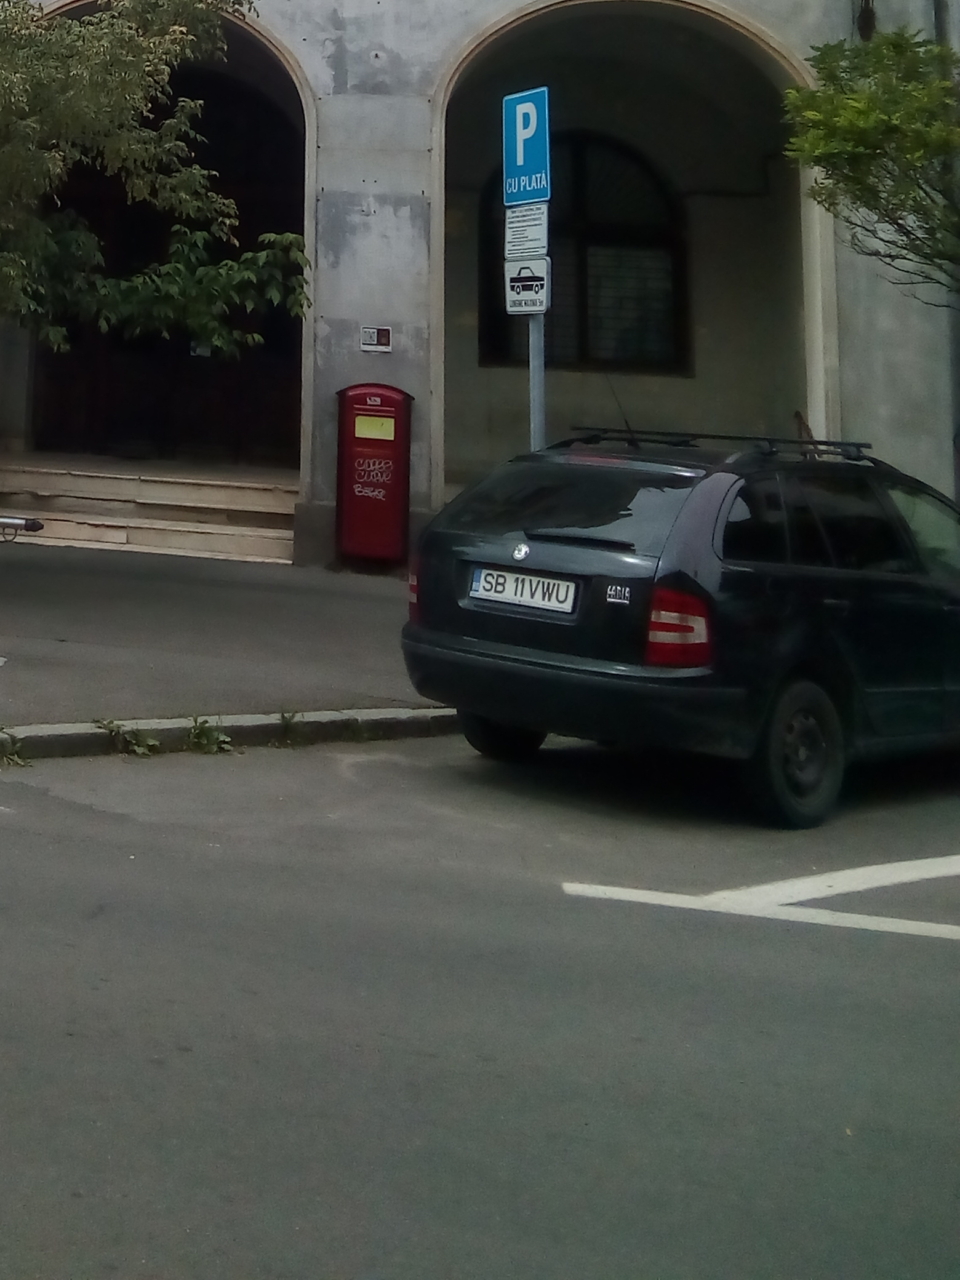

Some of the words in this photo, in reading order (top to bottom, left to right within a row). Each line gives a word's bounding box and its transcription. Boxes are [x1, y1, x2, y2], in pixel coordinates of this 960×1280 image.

[516, 102, 538, 166] P
[506, 176, 518, 194] CU
[482, 572, 507, 594] SB
